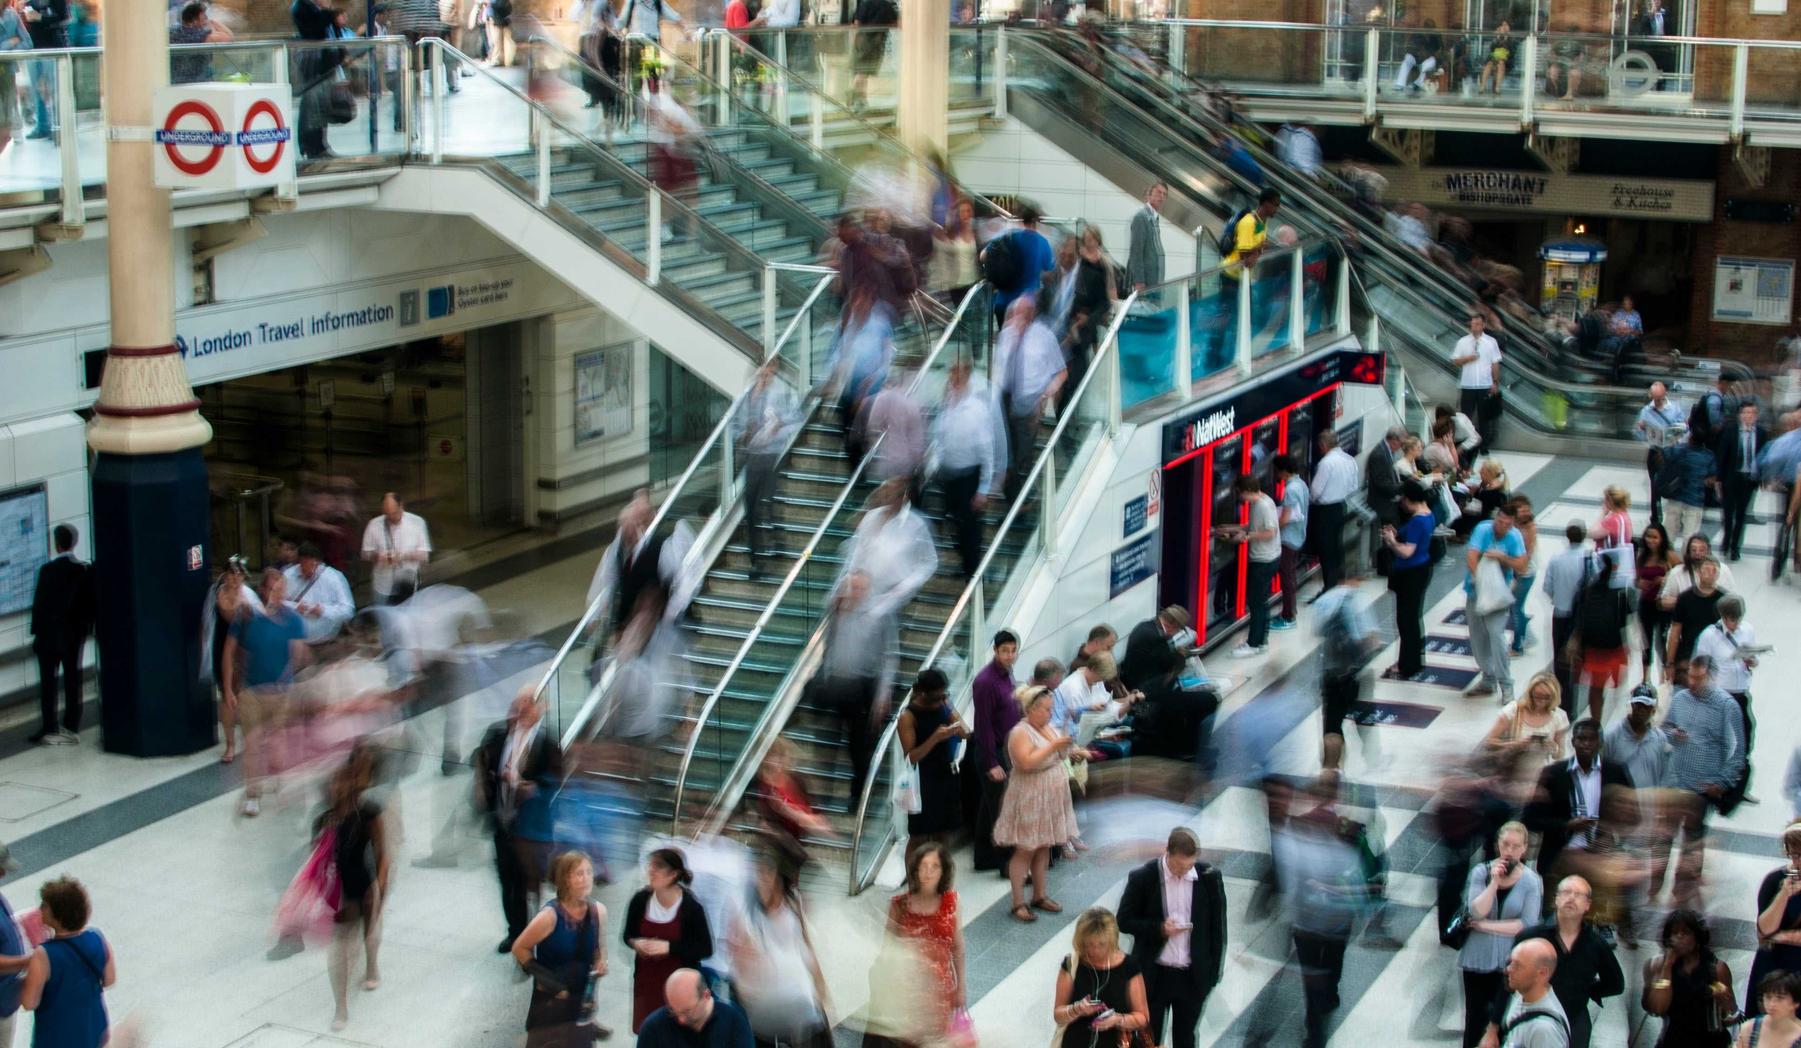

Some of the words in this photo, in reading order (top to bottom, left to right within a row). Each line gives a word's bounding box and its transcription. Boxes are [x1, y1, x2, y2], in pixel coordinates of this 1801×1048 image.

[160, 131, 228, 143] UNDERGROUND
[240, 131, 289, 142] UNDERGROUND
[1446, 172, 1548, 194] MERCHANT
[1460, 192, 1533, 205] BISHOPSGATE
[1627, 196, 1673, 209] Kitchen
[194, 329, 252, 357] London
[259, 318, 304, 343] Travel
[312, 304, 394, 336] Information
[1196, 405, 1235, 448] NatWest
